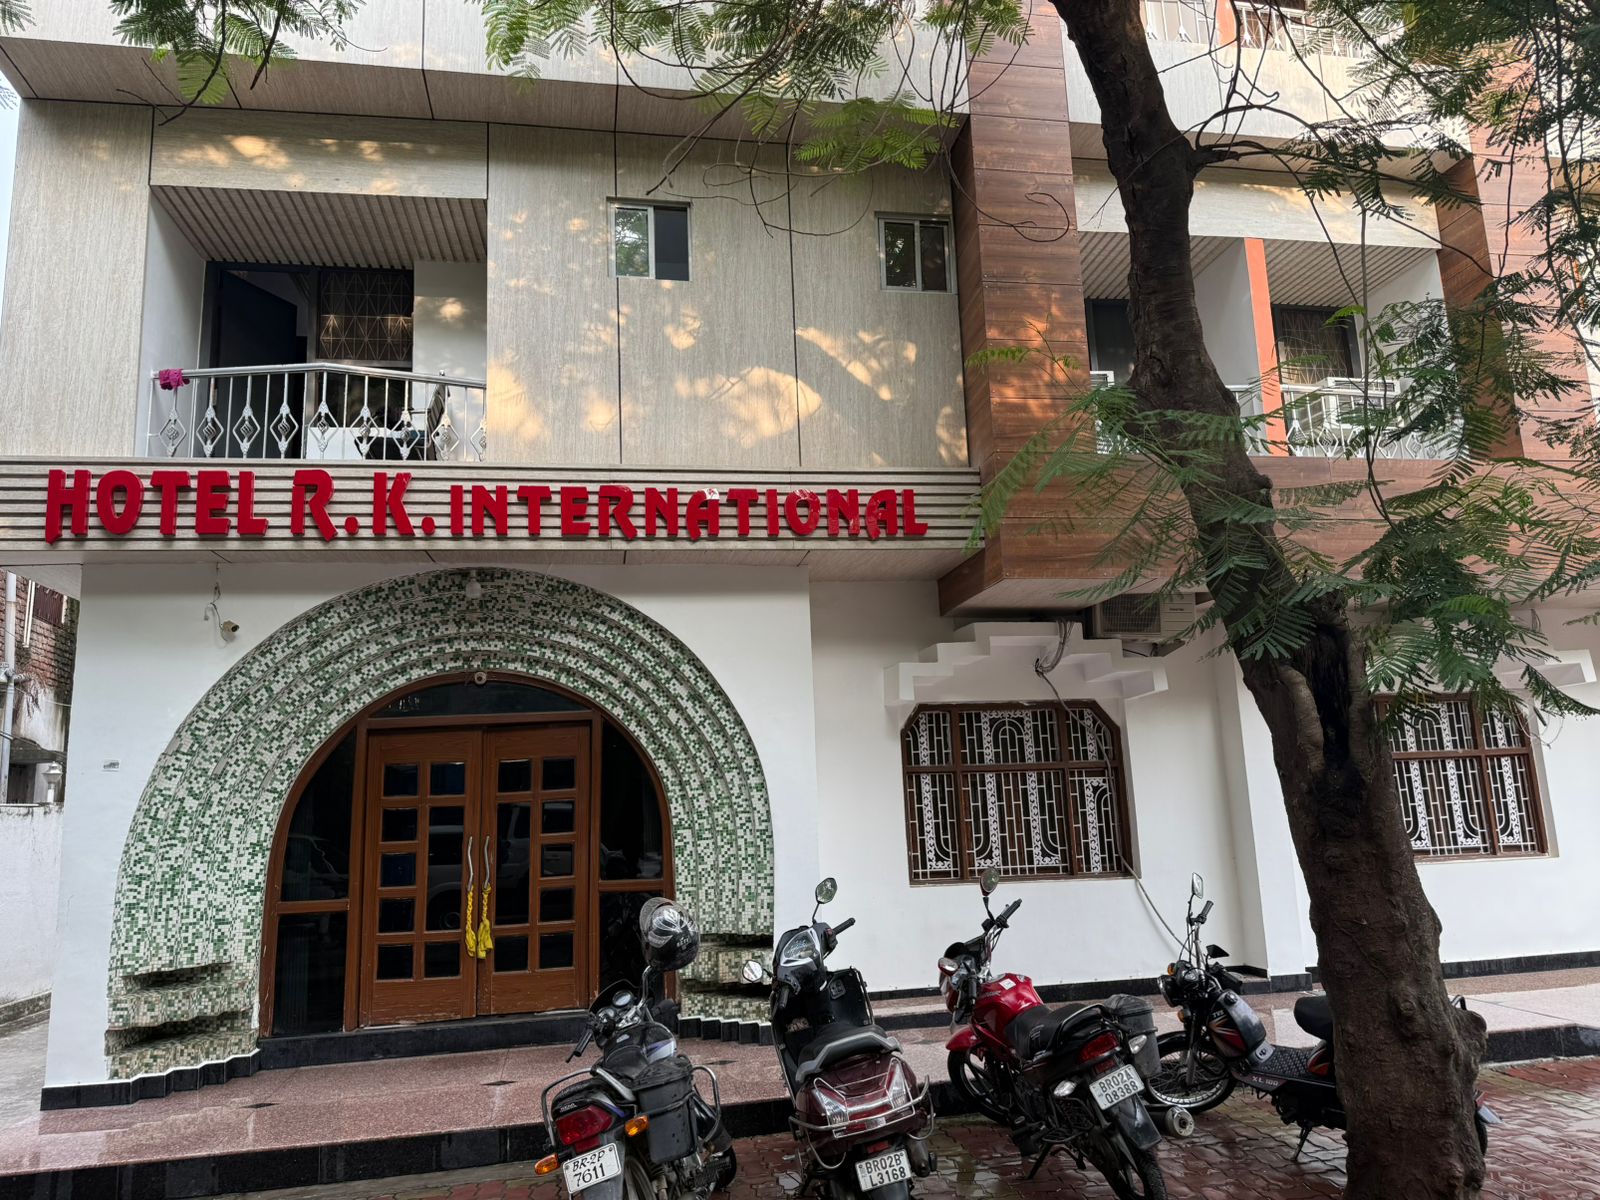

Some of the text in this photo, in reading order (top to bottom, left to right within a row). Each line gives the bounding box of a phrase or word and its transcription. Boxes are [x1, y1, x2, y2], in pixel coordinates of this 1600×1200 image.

[45, 469, 269, 545] HOTEL
[1099, 1070, 1134, 1093] BR02A
[573, 1162, 606, 1187] 7611
[865, 1153, 902, 1174] BR02B
[869, 1166, 906, 1187] L3168
